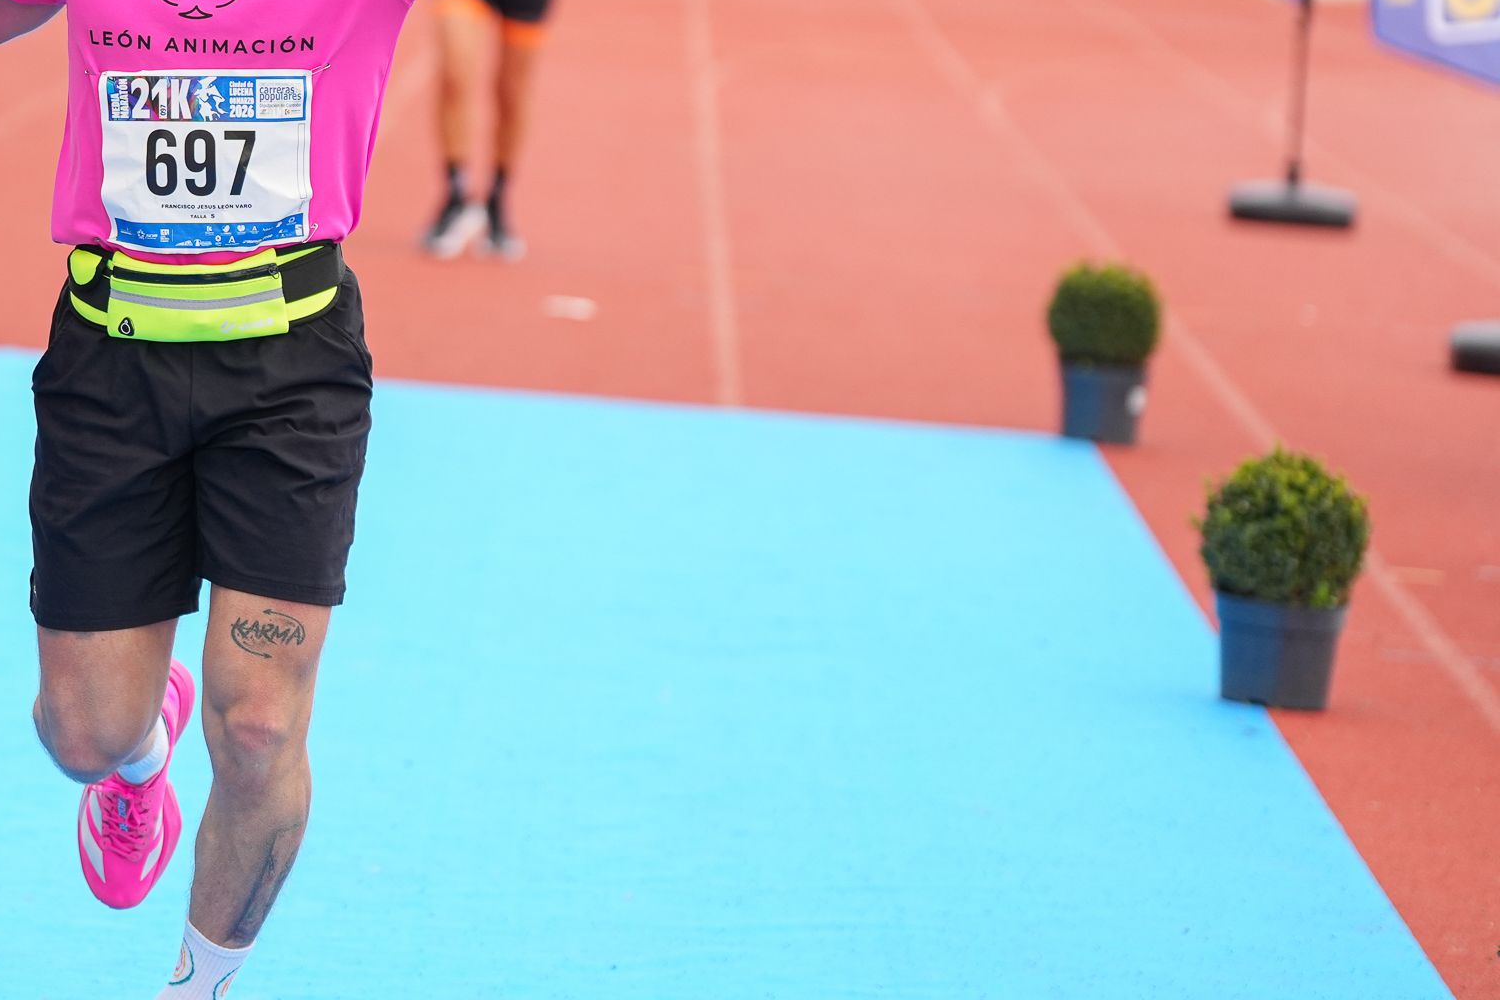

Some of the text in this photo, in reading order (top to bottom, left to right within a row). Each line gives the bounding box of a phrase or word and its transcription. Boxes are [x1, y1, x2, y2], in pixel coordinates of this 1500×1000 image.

[90, 30, 314, 54] LEÓN ANIMACIÓN
[130, 78, 192, 119] 21K
[259, 86, 295, 94] carreras
[259, 92, 302, 103] populares
[229, 105, 254, 118] 2026
[146, 129, 256, 197] 697
[232, 617, 304, 646] KARMA
